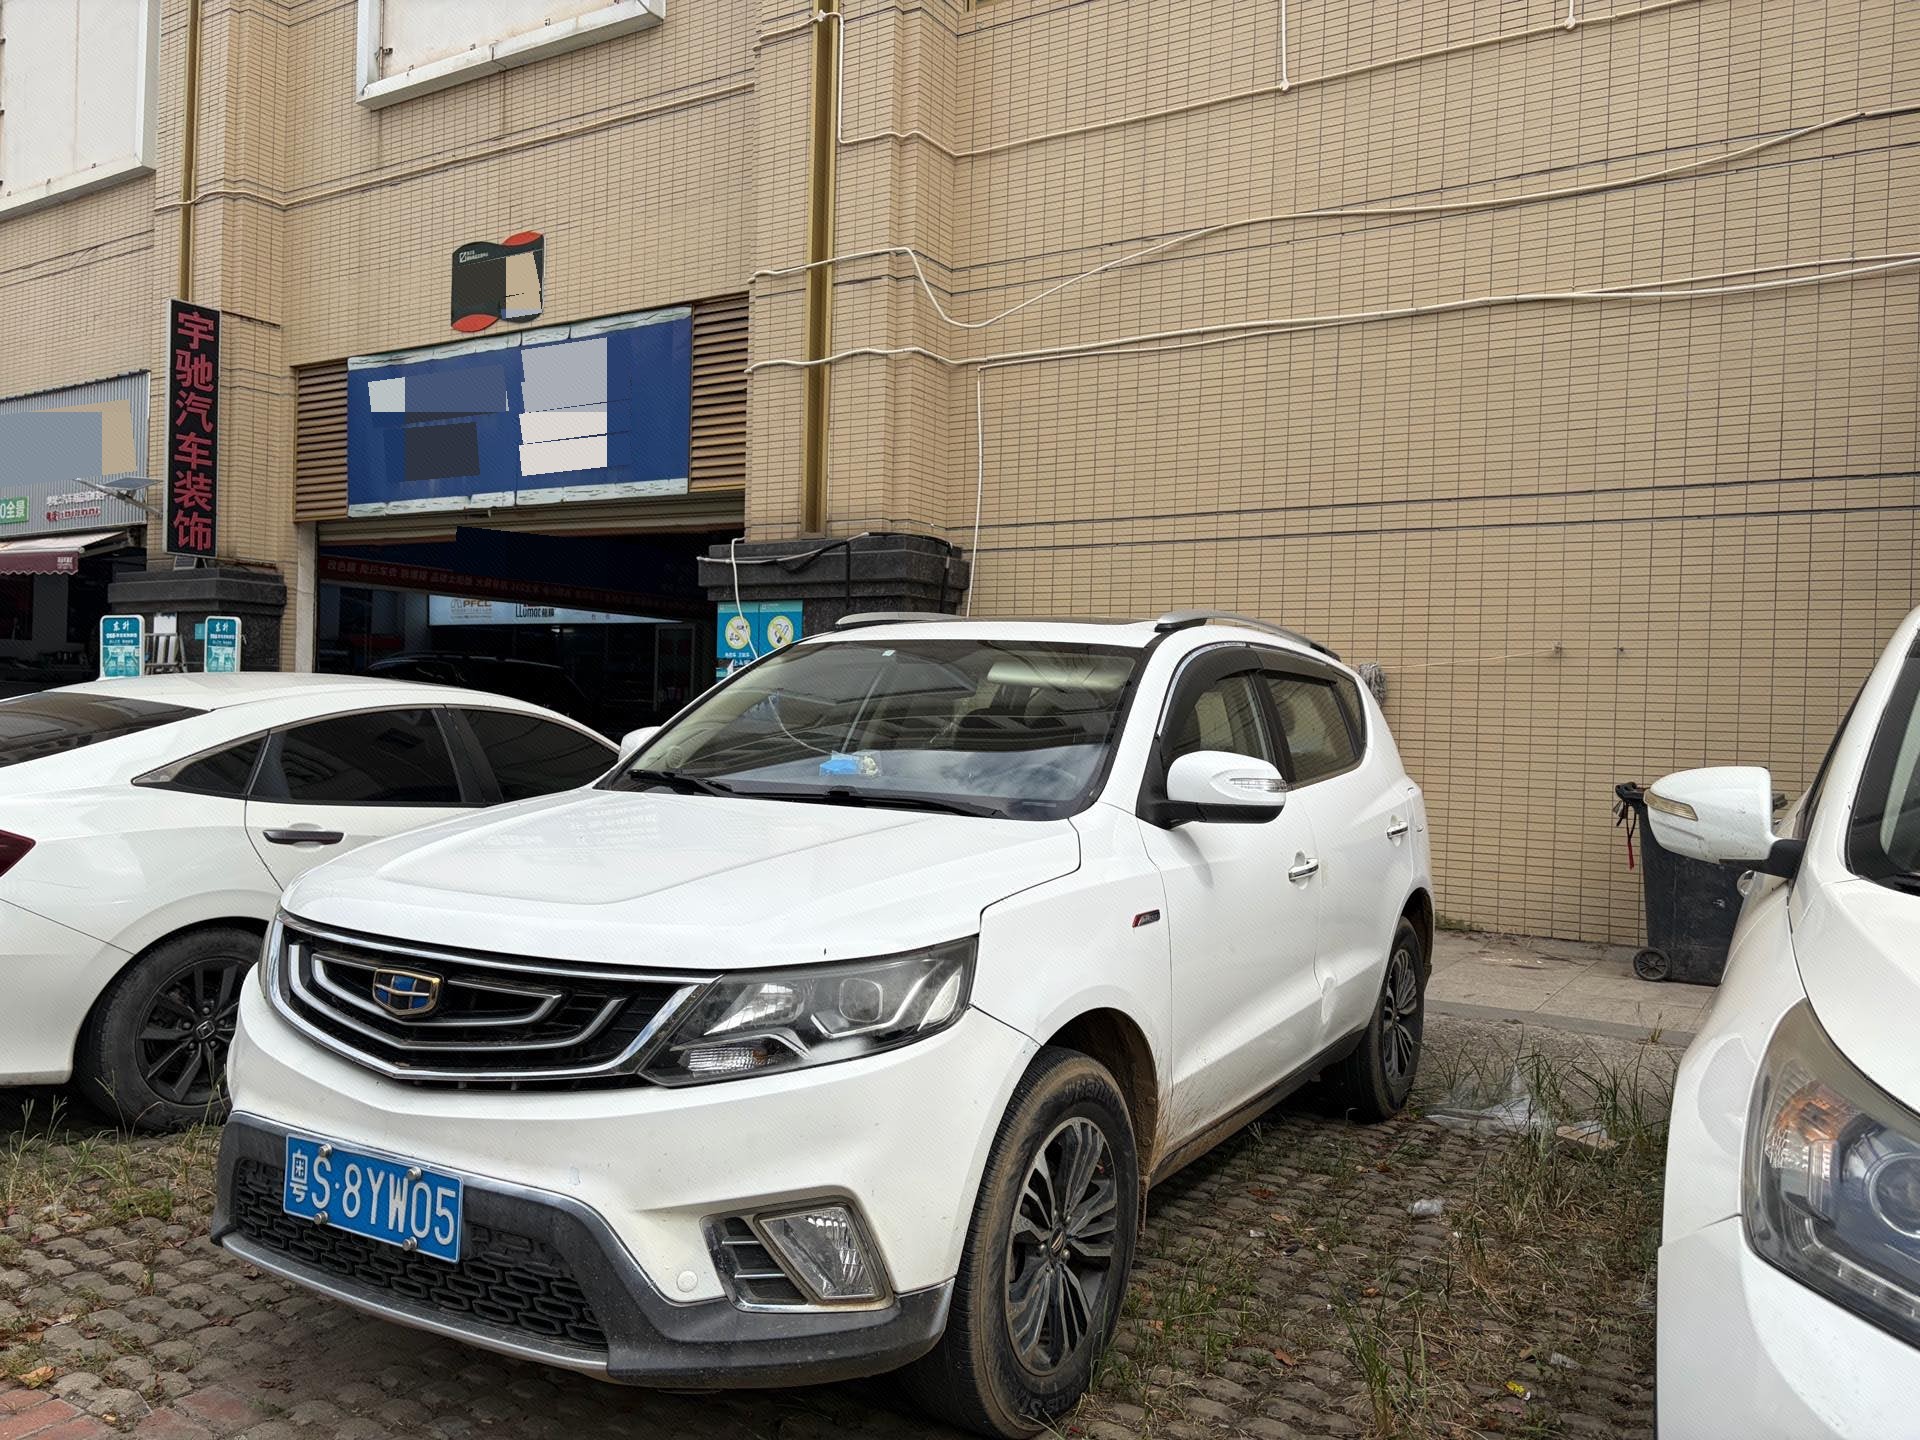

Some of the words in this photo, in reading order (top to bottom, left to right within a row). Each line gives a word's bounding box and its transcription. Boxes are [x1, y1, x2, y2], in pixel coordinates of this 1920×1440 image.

[173, 311, 215, 551] 宇驰汽车装饰
[289, 1149, 456, 1246] 粤S·8YW05
